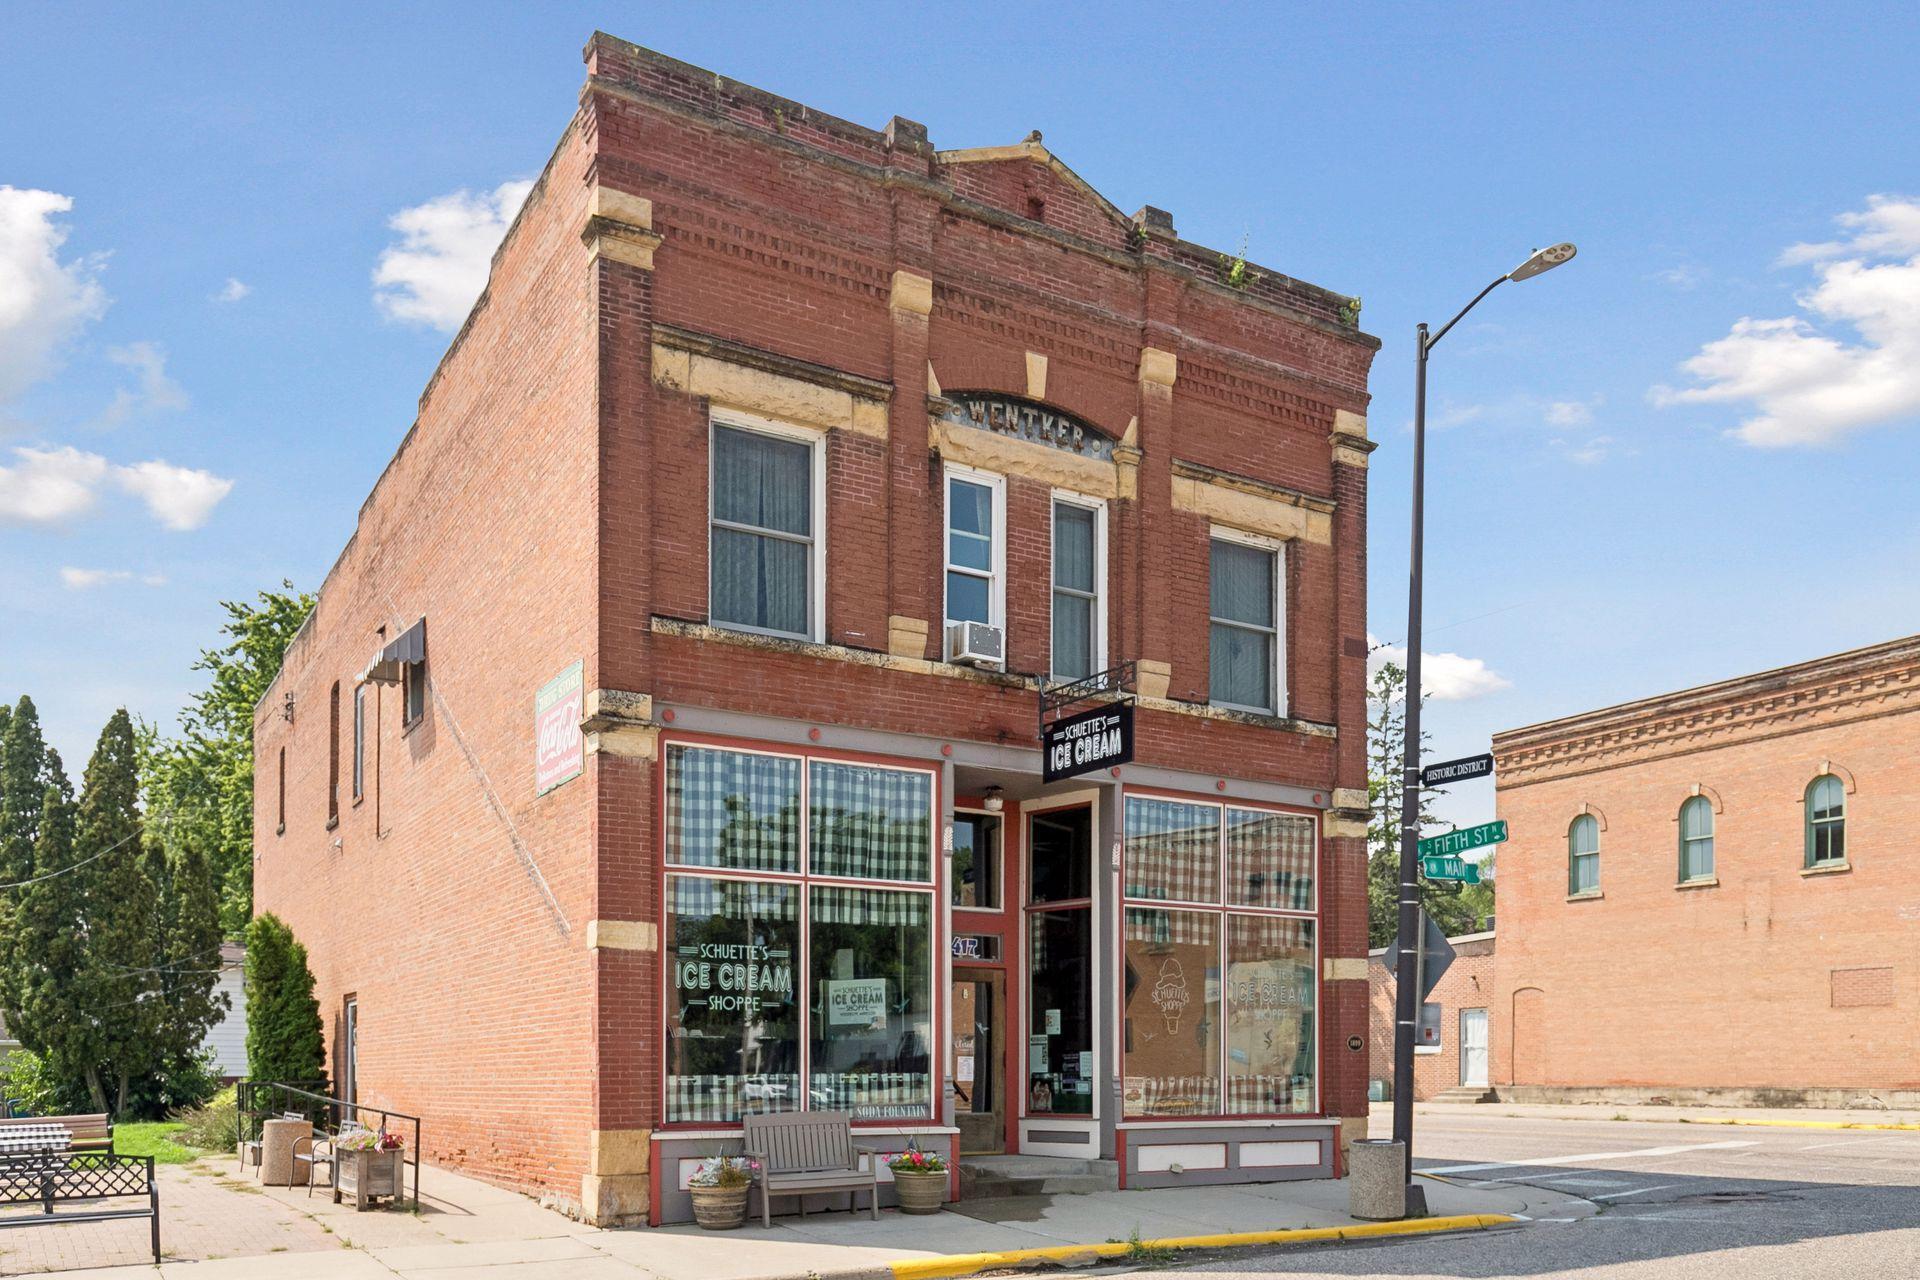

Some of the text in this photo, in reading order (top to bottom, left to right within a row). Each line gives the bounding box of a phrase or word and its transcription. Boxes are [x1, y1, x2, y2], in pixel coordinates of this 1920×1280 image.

[968, 400, 1085, 453] WENTKER
[1065, 716, 1107, 740] SCHUETTE'S
[1050, 728, 1122, 771] ICE CREAM
[1426, 760, 1488, 781] HISTORIC DISTRICT
[1434, 832, 1469, 854] FIFTH
[1474, 826, 1489, 845] ST
[700, 943, 768, 960] SCHUETTE'S
[951, 936, 978, 957] 417
[675, 961, 793, 992] ICE CREAM
[708, 995, 761, 1011] SHOPPE
[832, 992, 883, 1005] ICE CREAM
[857, 1105, 926, 1118] SODA FOUNTAIN
